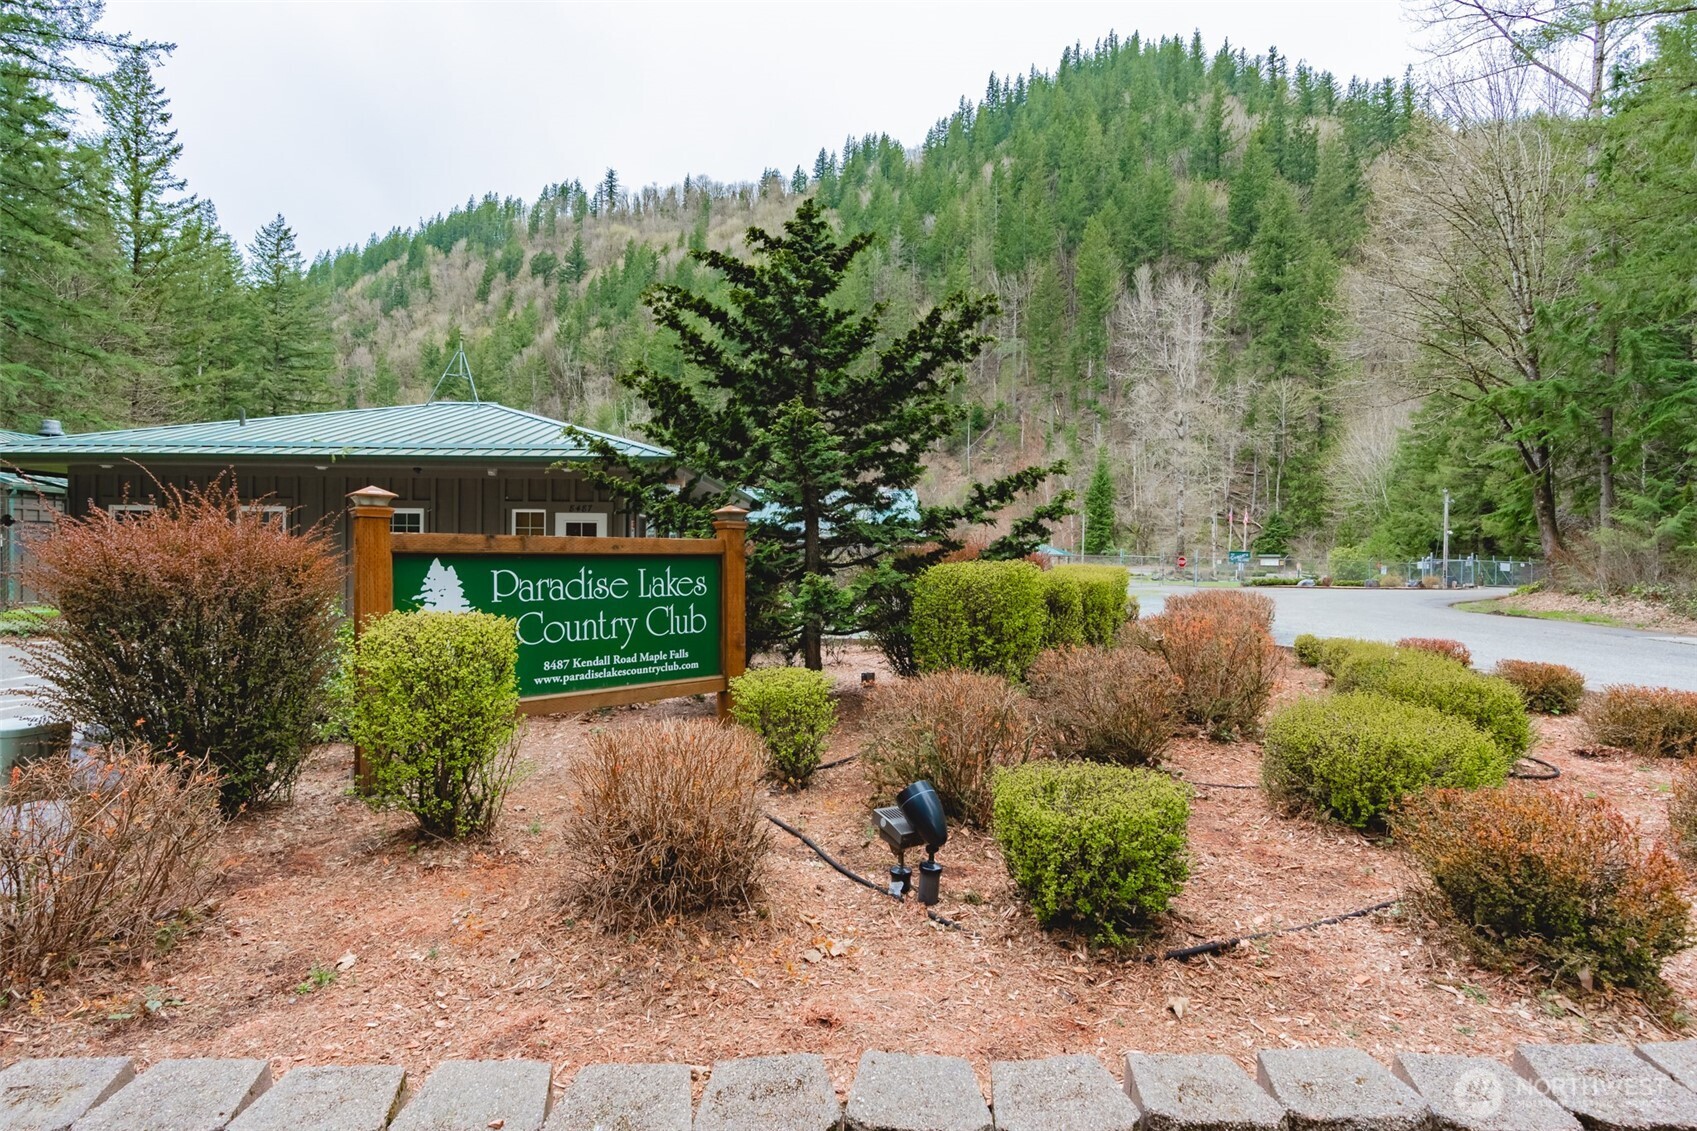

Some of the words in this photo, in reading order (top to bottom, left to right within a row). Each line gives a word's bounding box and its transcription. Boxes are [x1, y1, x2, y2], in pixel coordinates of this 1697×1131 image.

[490, 566, 629, 603] Paradise
[637, 566, 708, 599] Lakes
[515, 610, 639, 650] Country
[646, 603, 707, 637] Club
[533, 660, 699, 685] www.paradiselakescountryclub.com
[543, 659, 570, 671] 8487
[572, 655, 611, 668] Kendall
[613, 653, 638, 665] Road
[639, 651, 668, 664] Maple
[669, 649, 689, 660] Falls
